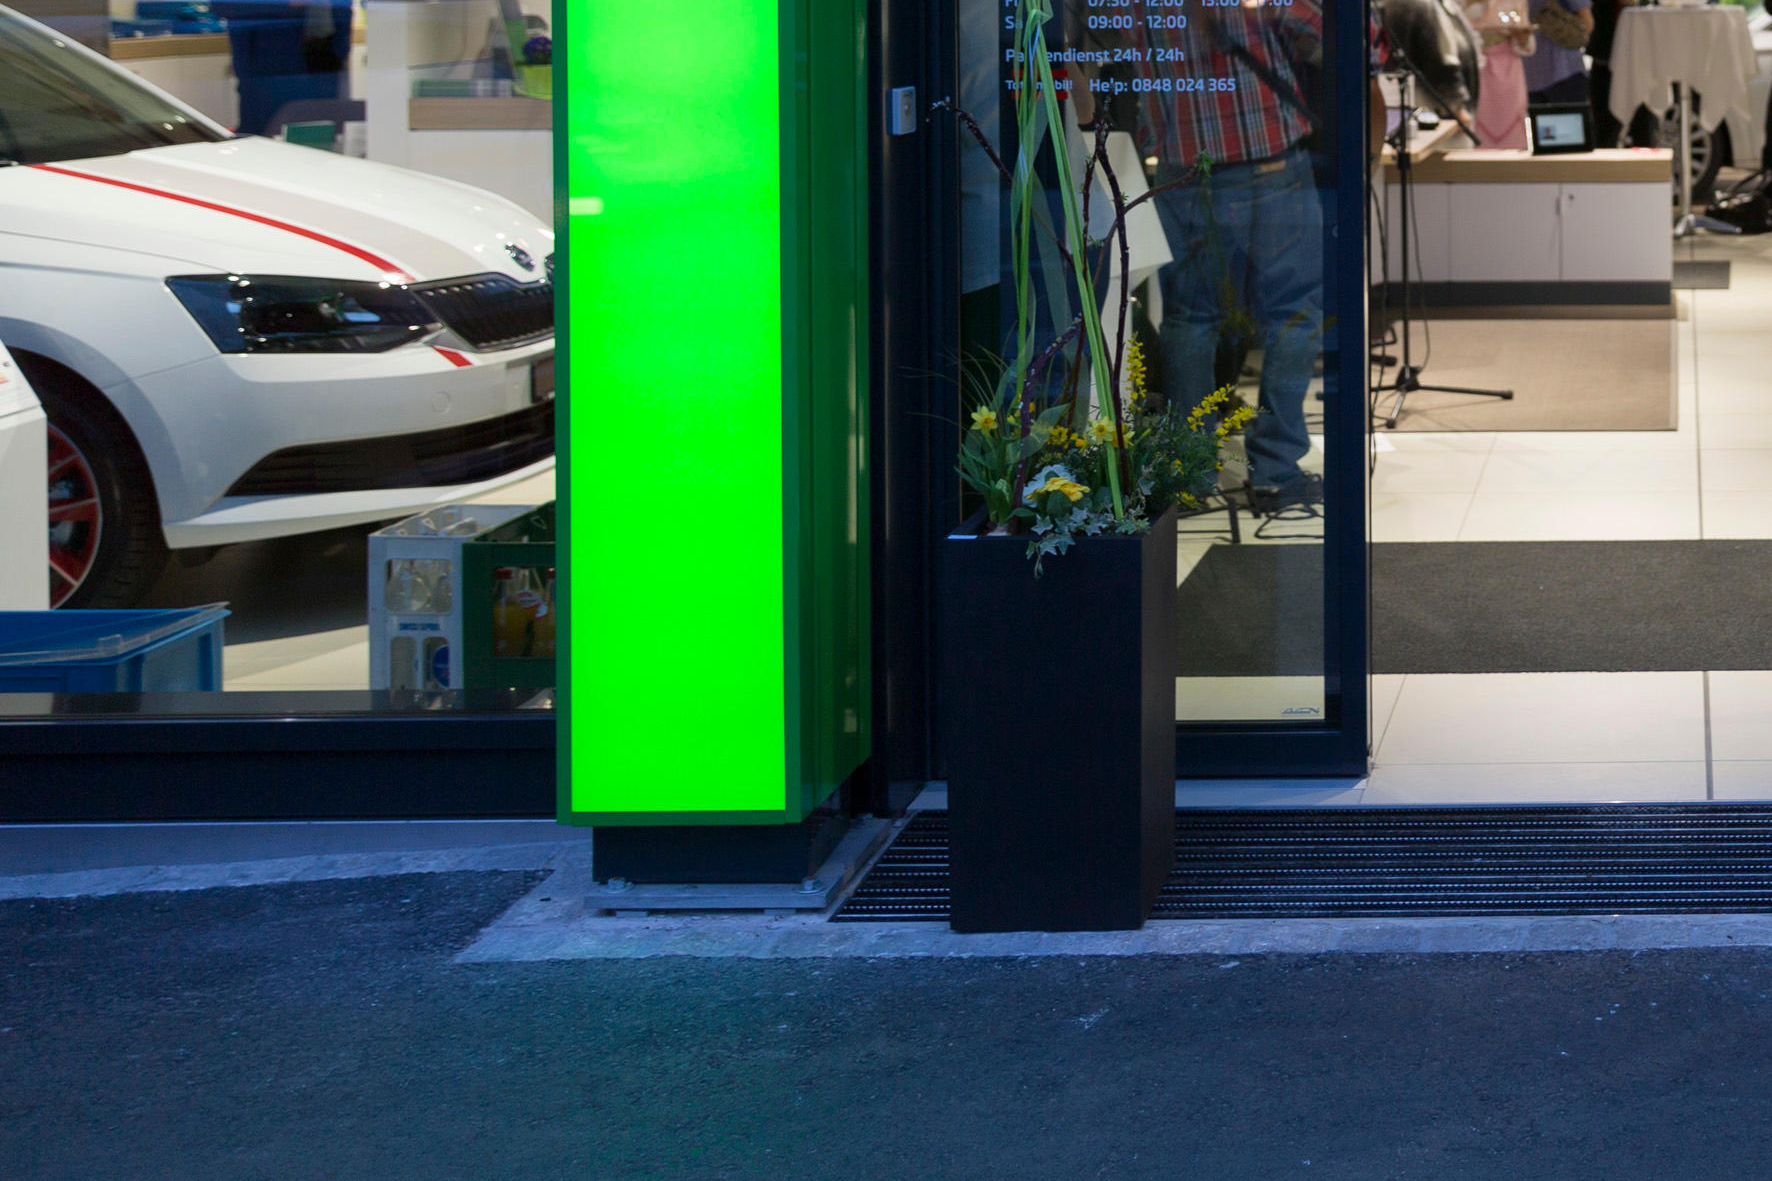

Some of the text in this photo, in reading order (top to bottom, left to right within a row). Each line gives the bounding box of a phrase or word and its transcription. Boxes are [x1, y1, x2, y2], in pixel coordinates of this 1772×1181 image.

[1088, 15, 1133, 29] 09:00
[1146, 15, 1187, 29] 12:00
[1114, 48, 1142, 61] 24h
[1156, 48, 1184, 61] 24h
[1132, 78, 1172, 91] 0848
[1176, 78, 1204, 91] 024
[1208, 78, 1236, 91] 365
